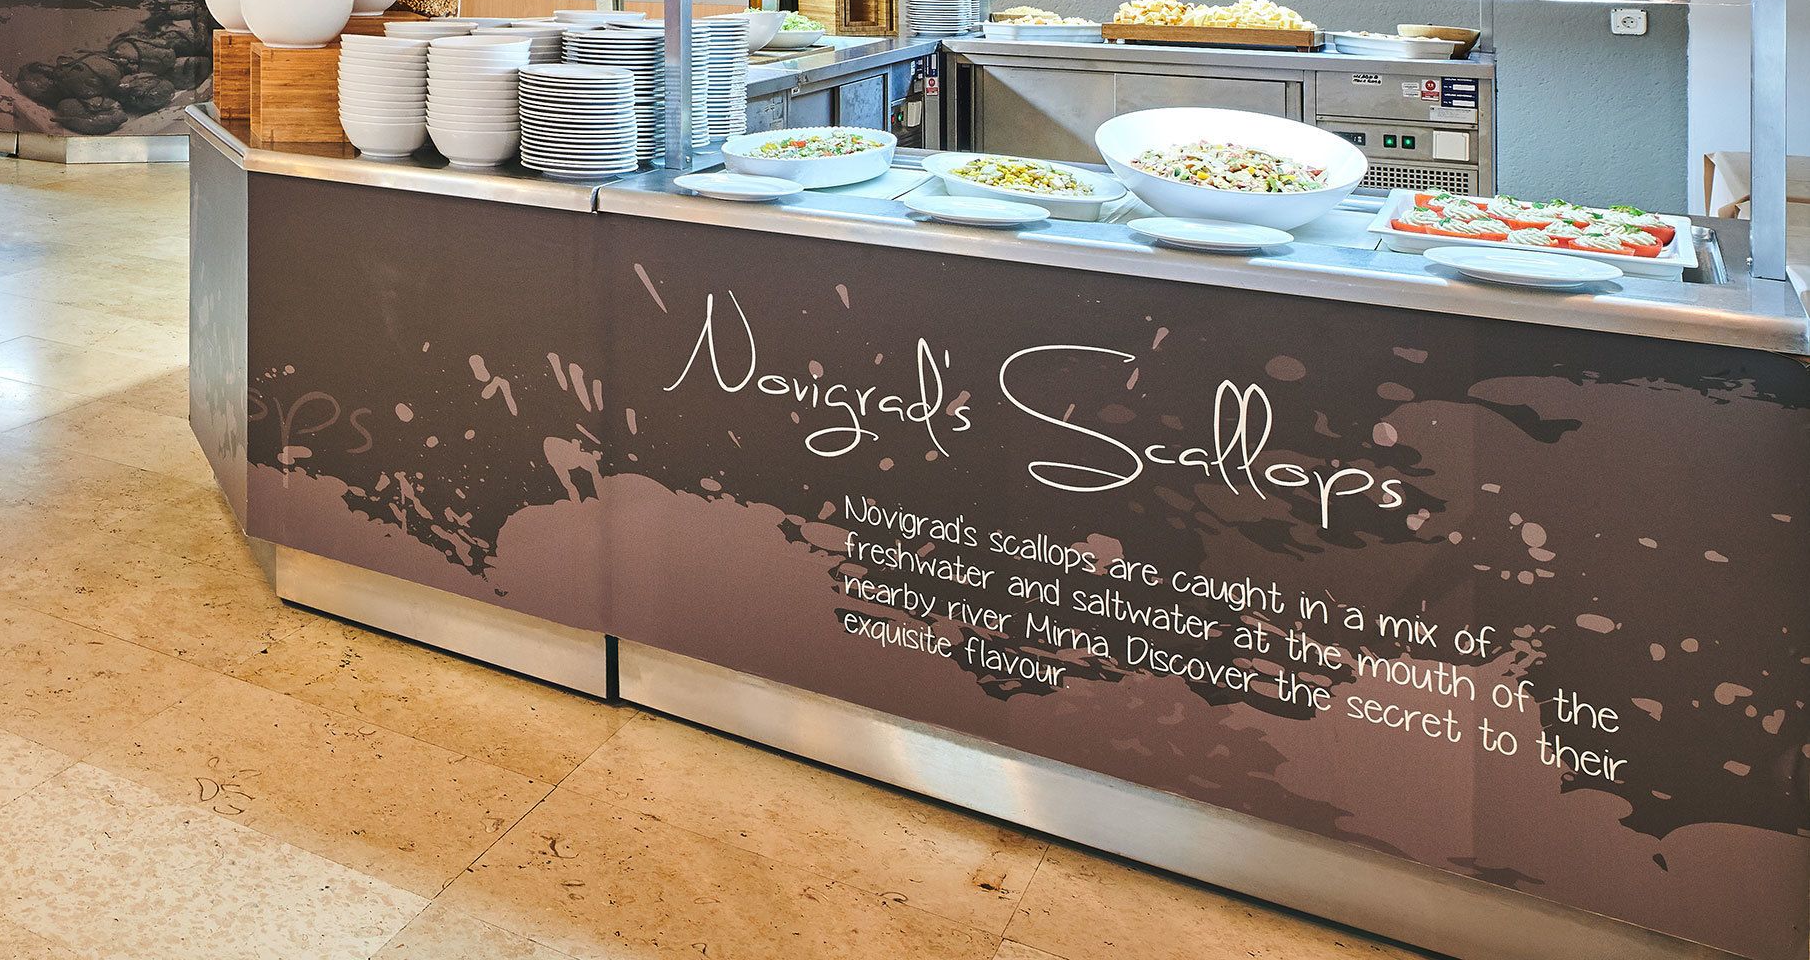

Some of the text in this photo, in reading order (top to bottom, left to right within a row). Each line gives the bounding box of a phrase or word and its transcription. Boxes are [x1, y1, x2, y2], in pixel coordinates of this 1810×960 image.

[663, 291, 1404, 528] Novigrad's Scallops
[844, 612, 1070, 689] exquisite flavour.
[845, 495, 1496, 658] Novigrad's scallops are caught in a mix of
[845, 532, 1620, 733] freshwater and saltwater at the mouth of the
[845, 575, 1628, 782] nearby river Mirna. Discover the secret to their
